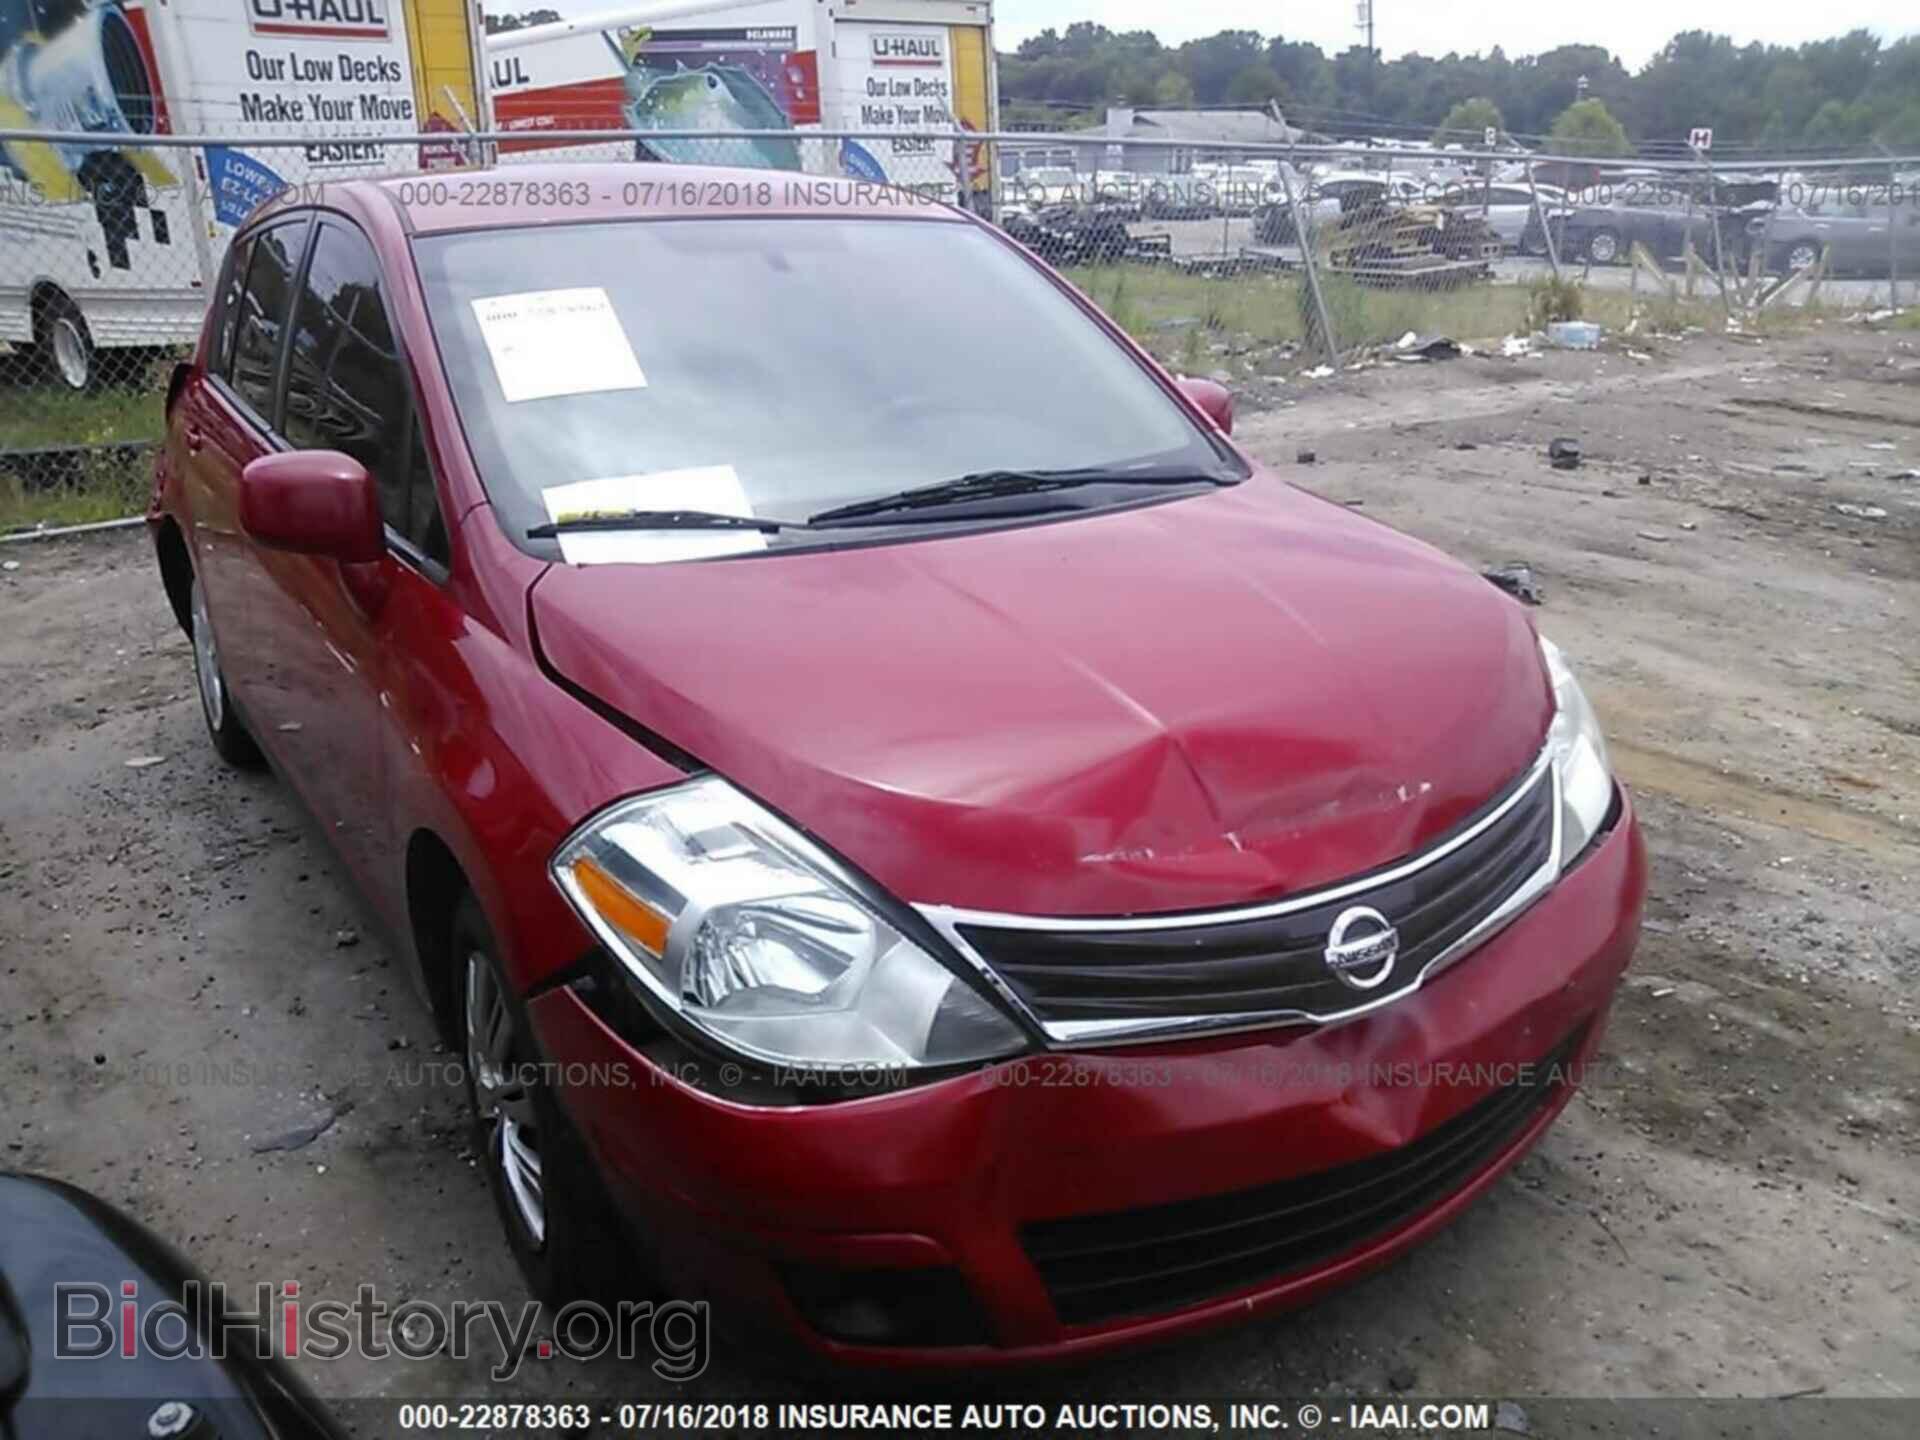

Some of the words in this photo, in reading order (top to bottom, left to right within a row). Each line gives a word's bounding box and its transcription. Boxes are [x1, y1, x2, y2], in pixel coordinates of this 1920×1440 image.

[873, 39, 941, 56] U-HAUL
[246, 50, 286, 81] Our
[290, 52, 334, 82] Low
[338, 54, 402, 82] Decks
[490, 57, 531, 88] UL
[866, 77, 886, 97] Our
[889, 77, 911, 97] Low
[240, 93, 304, 122] Make
[307, 94, 355, 122] Your
[359, 94, 413, 121] Move
[861, 105, 894, 125] Make
[896, 105, 921, 125] Your
